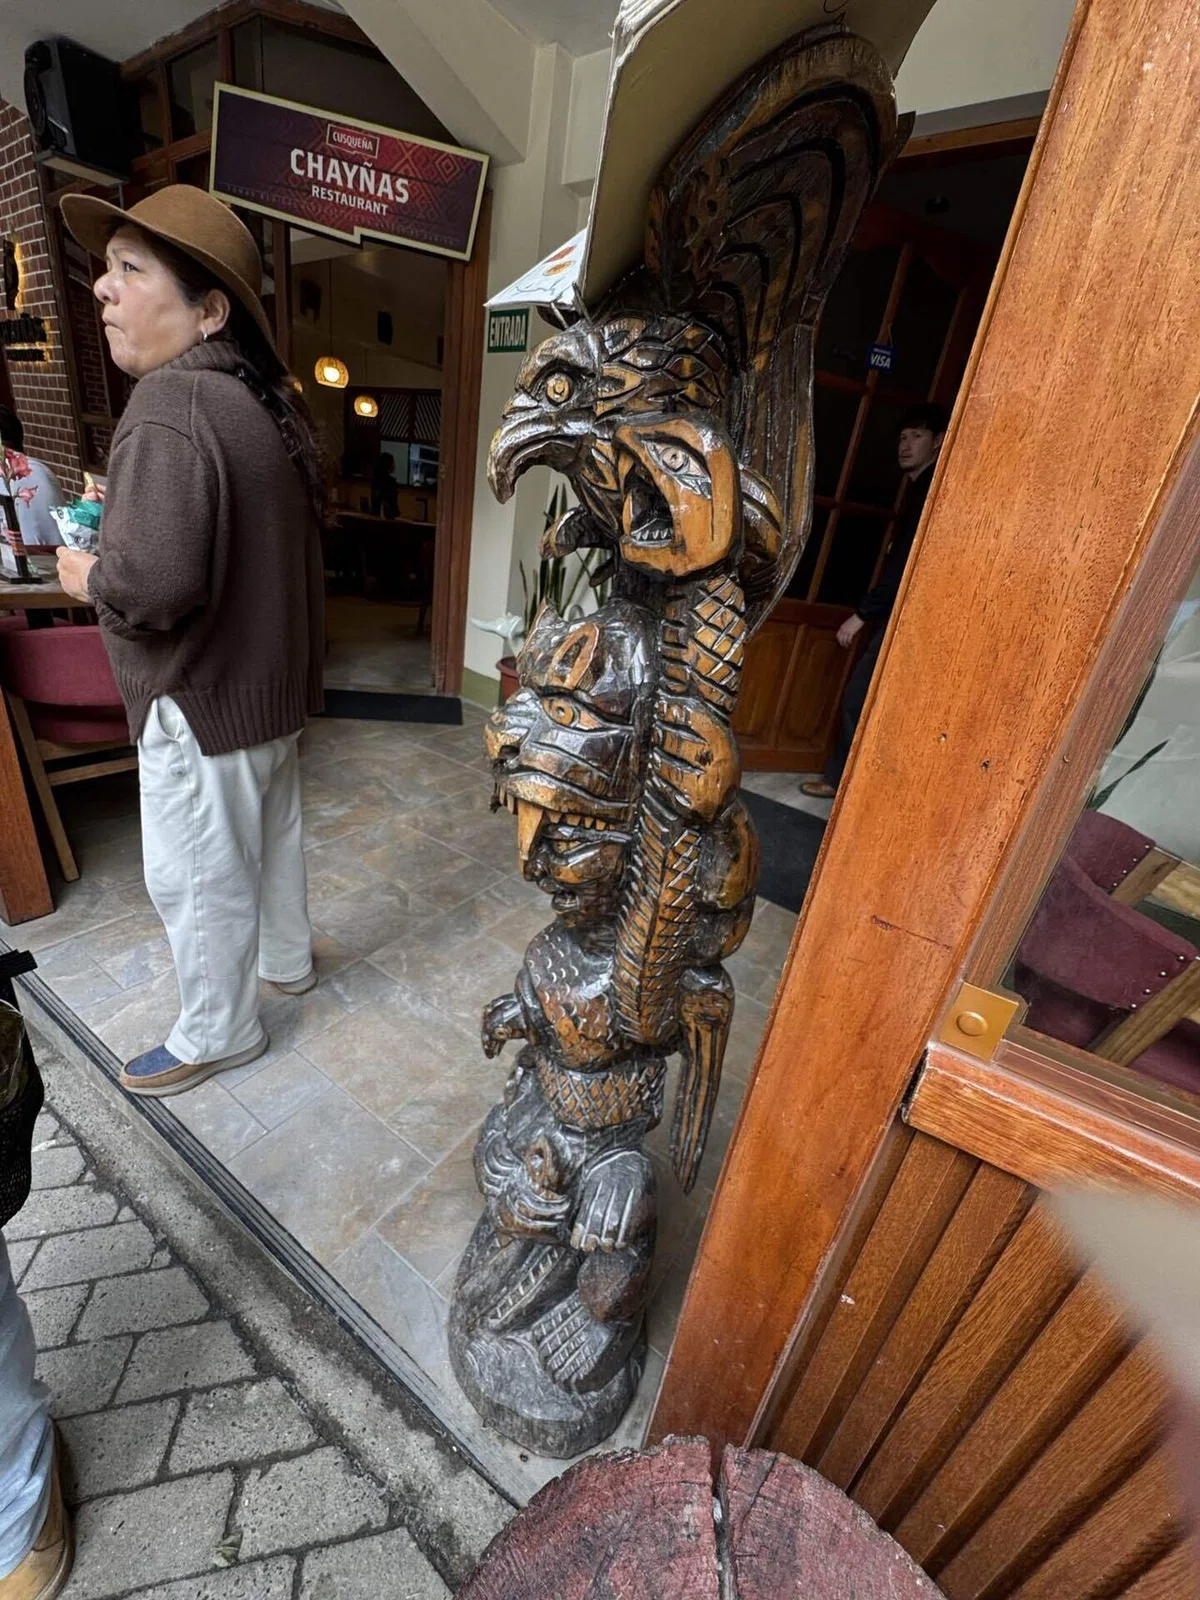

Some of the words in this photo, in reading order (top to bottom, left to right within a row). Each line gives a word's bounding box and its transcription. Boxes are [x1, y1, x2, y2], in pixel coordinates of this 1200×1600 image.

[332, 131, 374, 151] CUSQUEÑA
[290, 148, 409, 204] CHAYÑAS
[311, 184, 388, 216] RESTAURANT
[490, 314, 526, 347] ENTRADA
[870, 353, 891, 369] VISA
